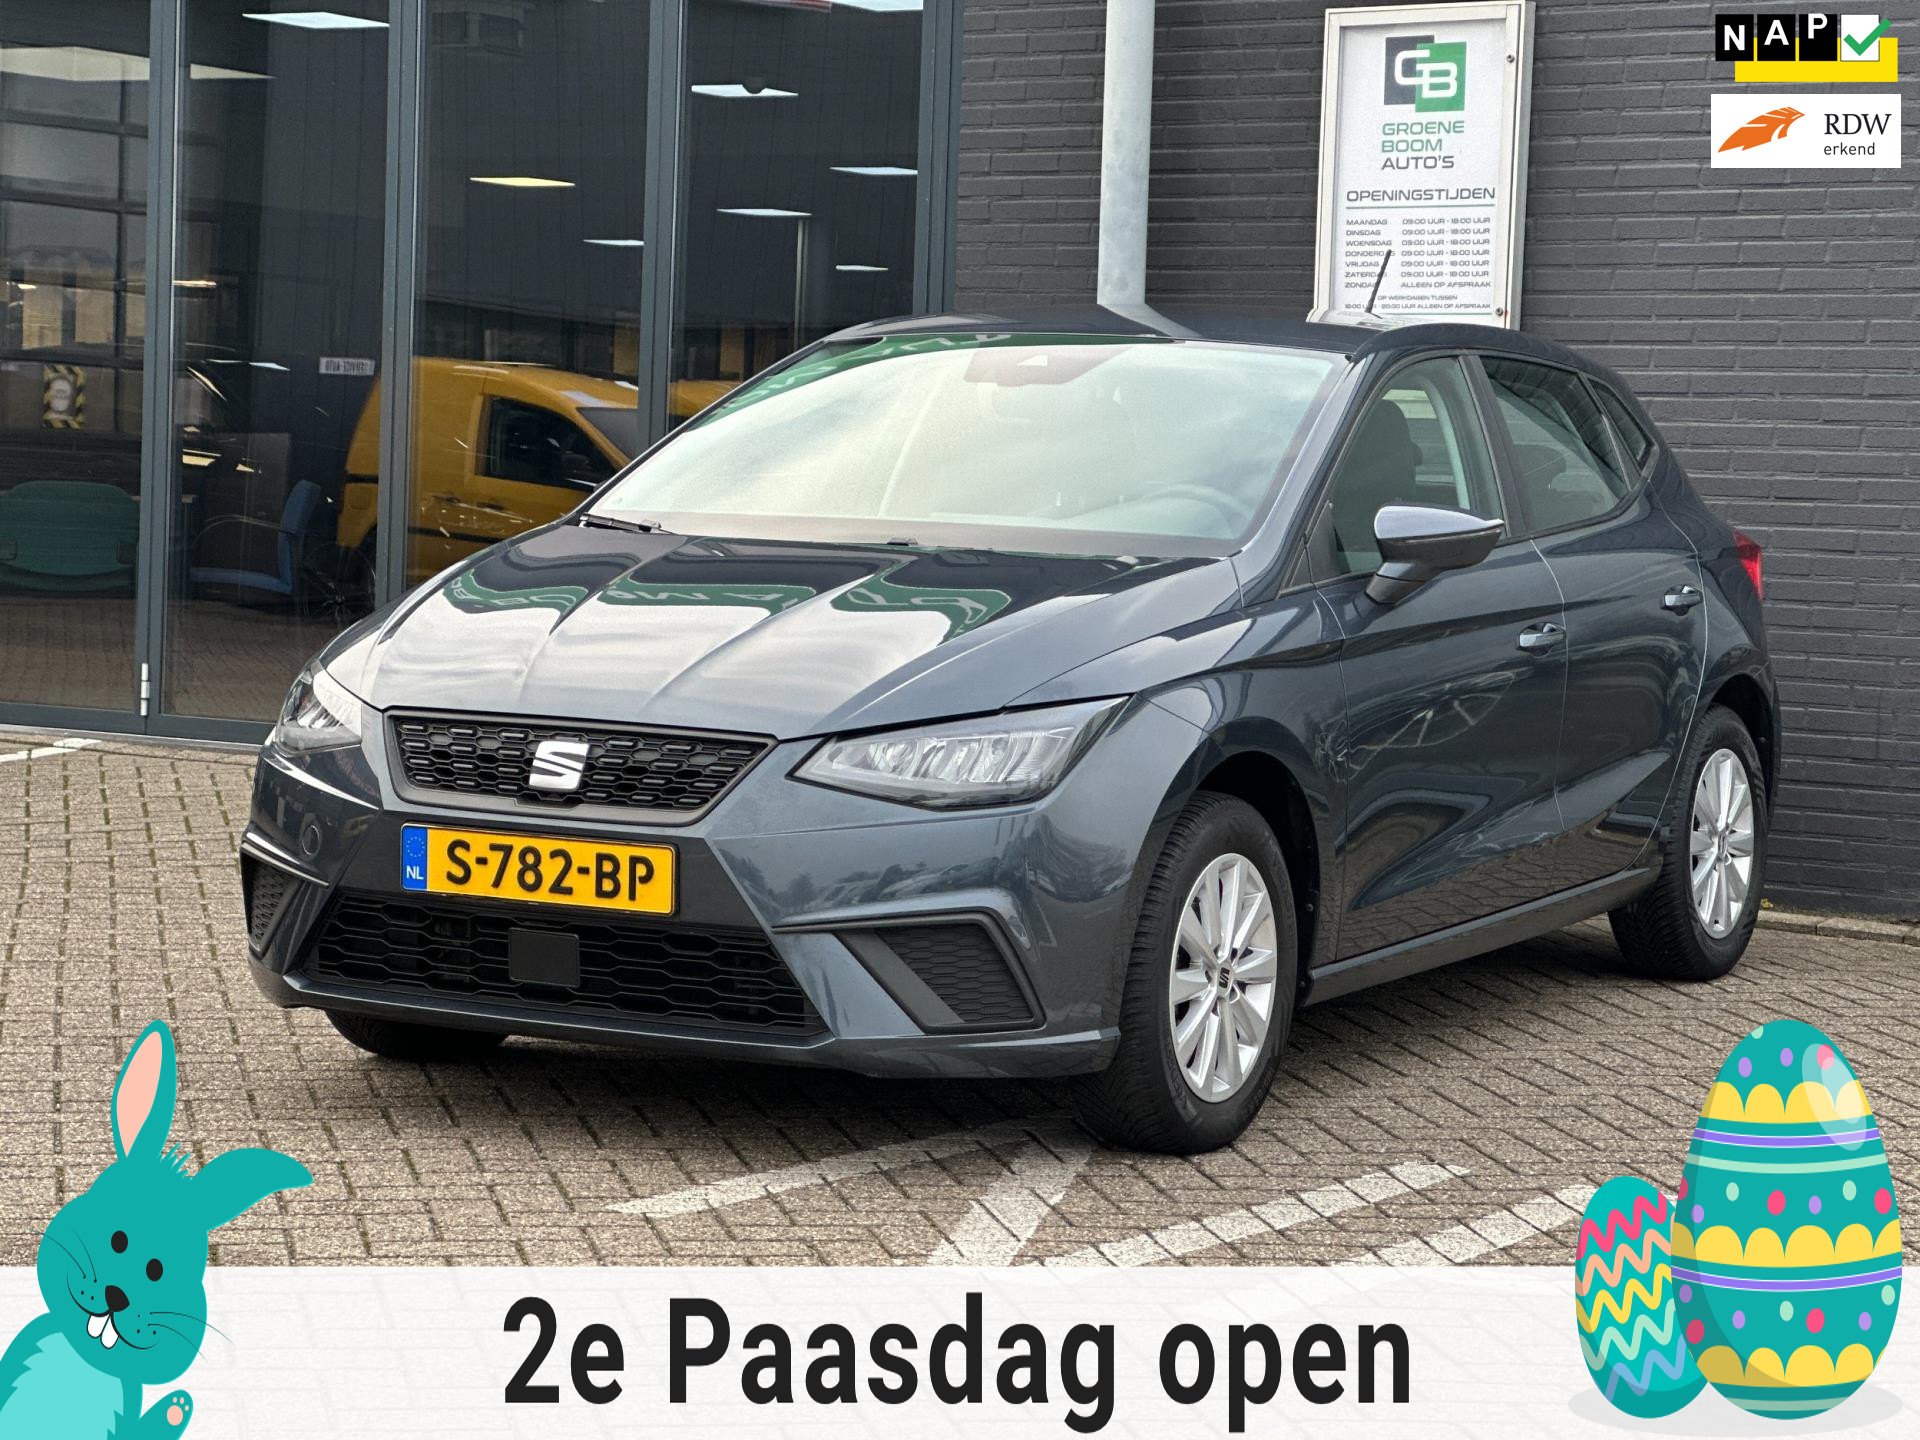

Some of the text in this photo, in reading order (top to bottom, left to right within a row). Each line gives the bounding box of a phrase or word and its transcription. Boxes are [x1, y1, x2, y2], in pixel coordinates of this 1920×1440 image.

[1382, 120, 1465, 135] GROENE
[1381, 138, 1443, 153] BOOM
[1381, 155, 1455, 170] AUTO'S
[1346, 187, 1496, 202] OPENINGSTIJDEN
[1345, 239, 1392, 247] WOENSDAG
[1345, 260, 1380, 268] VRIJDAG
[1433, 280, 1446, 288] OP
[1446, 280, 1492, 288] AFSPRAAK
[406, 865, 424, 880] NL
[446, 839, 655, 902] S-782-BP
